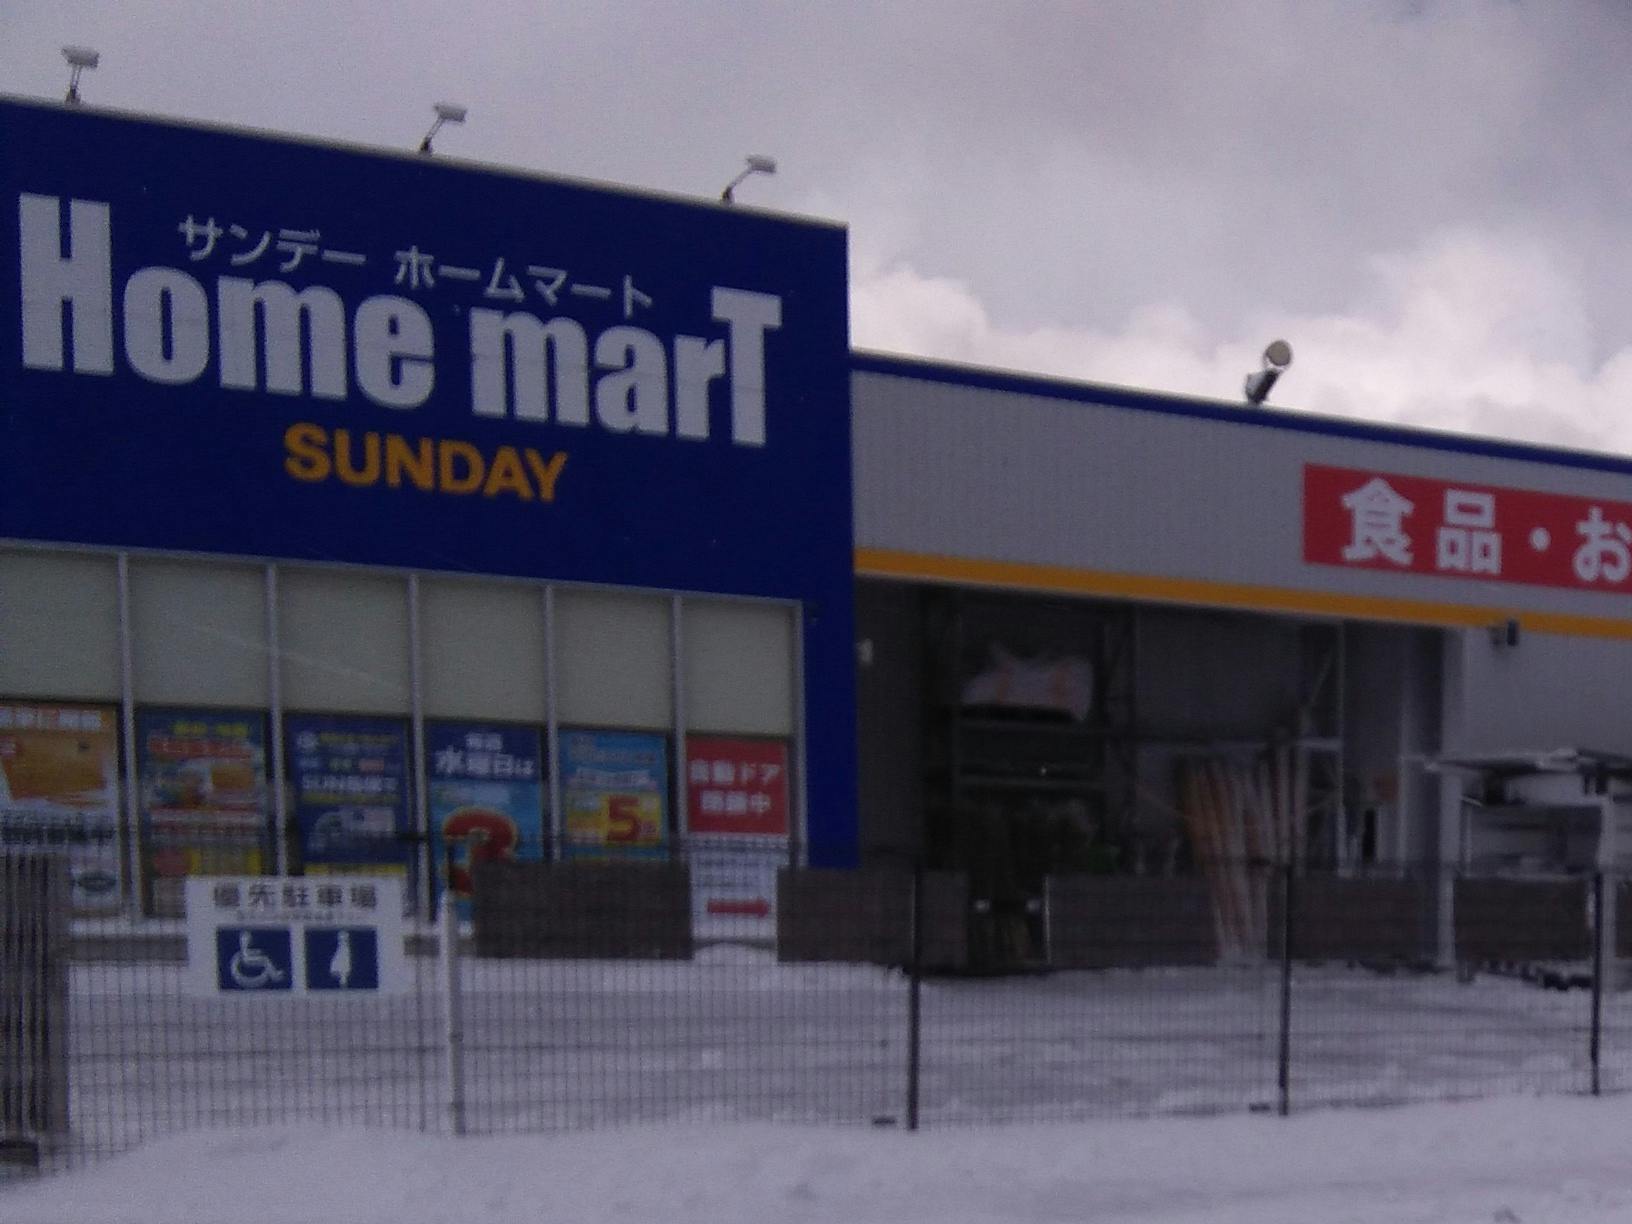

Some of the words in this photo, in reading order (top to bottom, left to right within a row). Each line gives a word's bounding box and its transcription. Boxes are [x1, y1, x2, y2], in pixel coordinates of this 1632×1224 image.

[19, 193, 435, 409] Home
[178, 215, 366, 272] サンデー
[394, 244, 653, 317] ホームマート
[284, 422, 568, 502] SUNDAY
